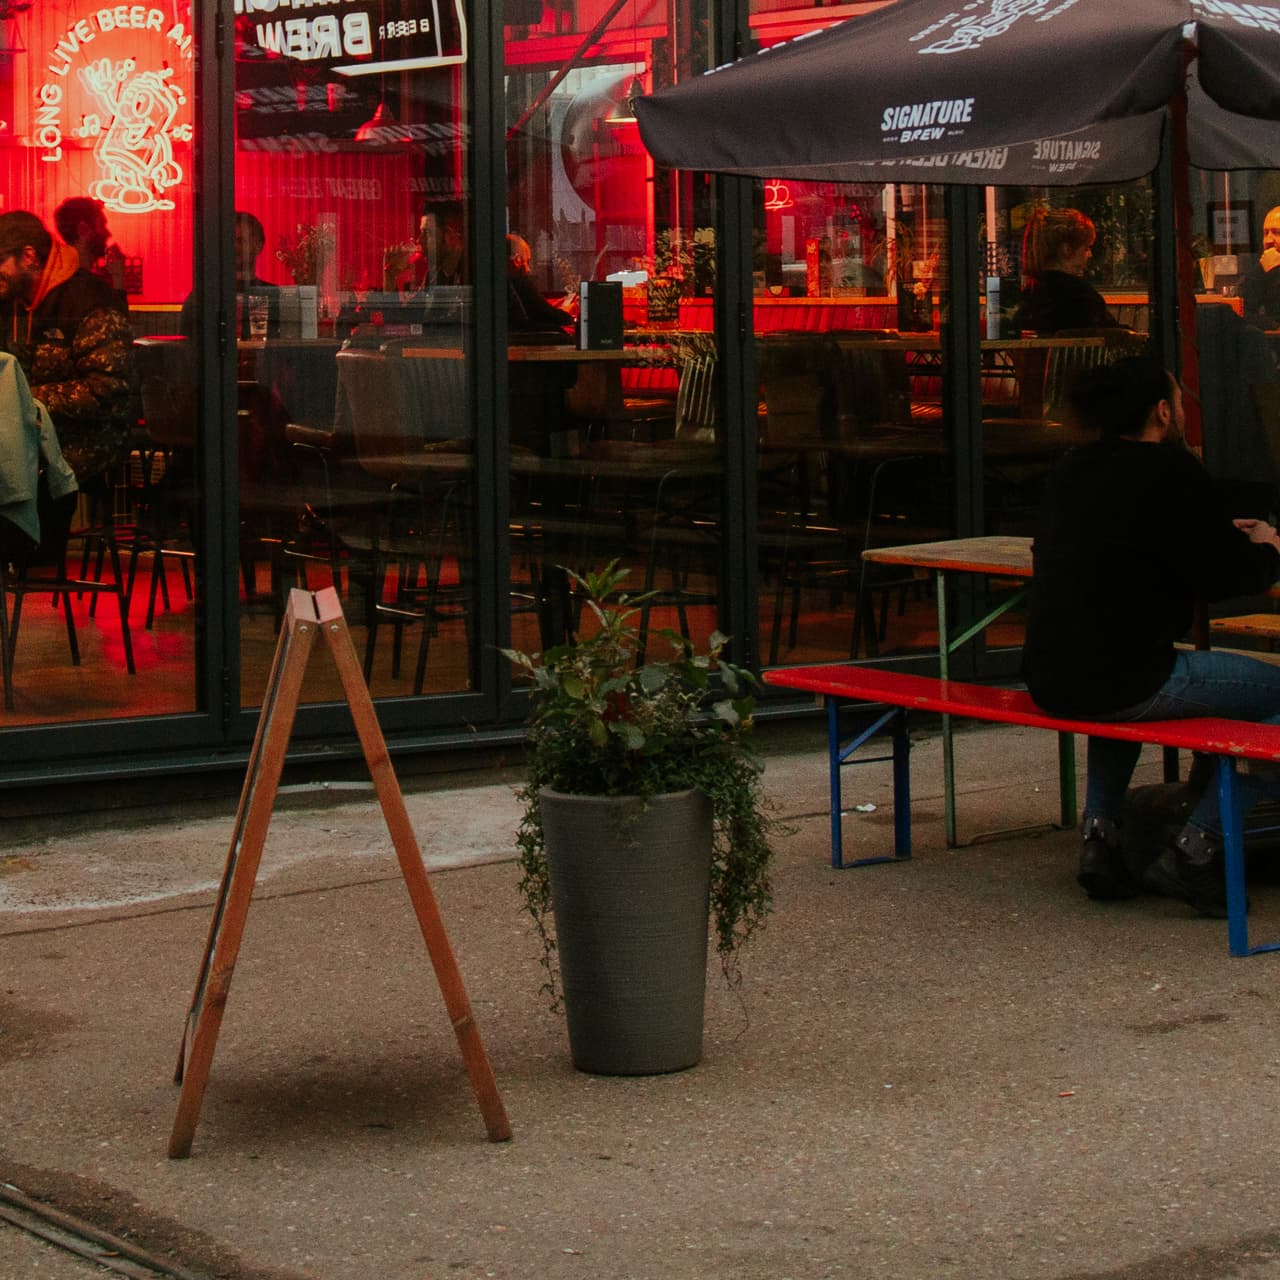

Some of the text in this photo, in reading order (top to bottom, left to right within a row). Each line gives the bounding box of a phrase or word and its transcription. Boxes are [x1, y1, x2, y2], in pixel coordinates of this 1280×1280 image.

[95, 5, 165, 33] BEER
[48, 18, 96, 77] LIVE
[37, 83, 63, 162] LONG
[880, 98, 976, 132] SIGNATURE
[899, 126, 945, 144] BREW
